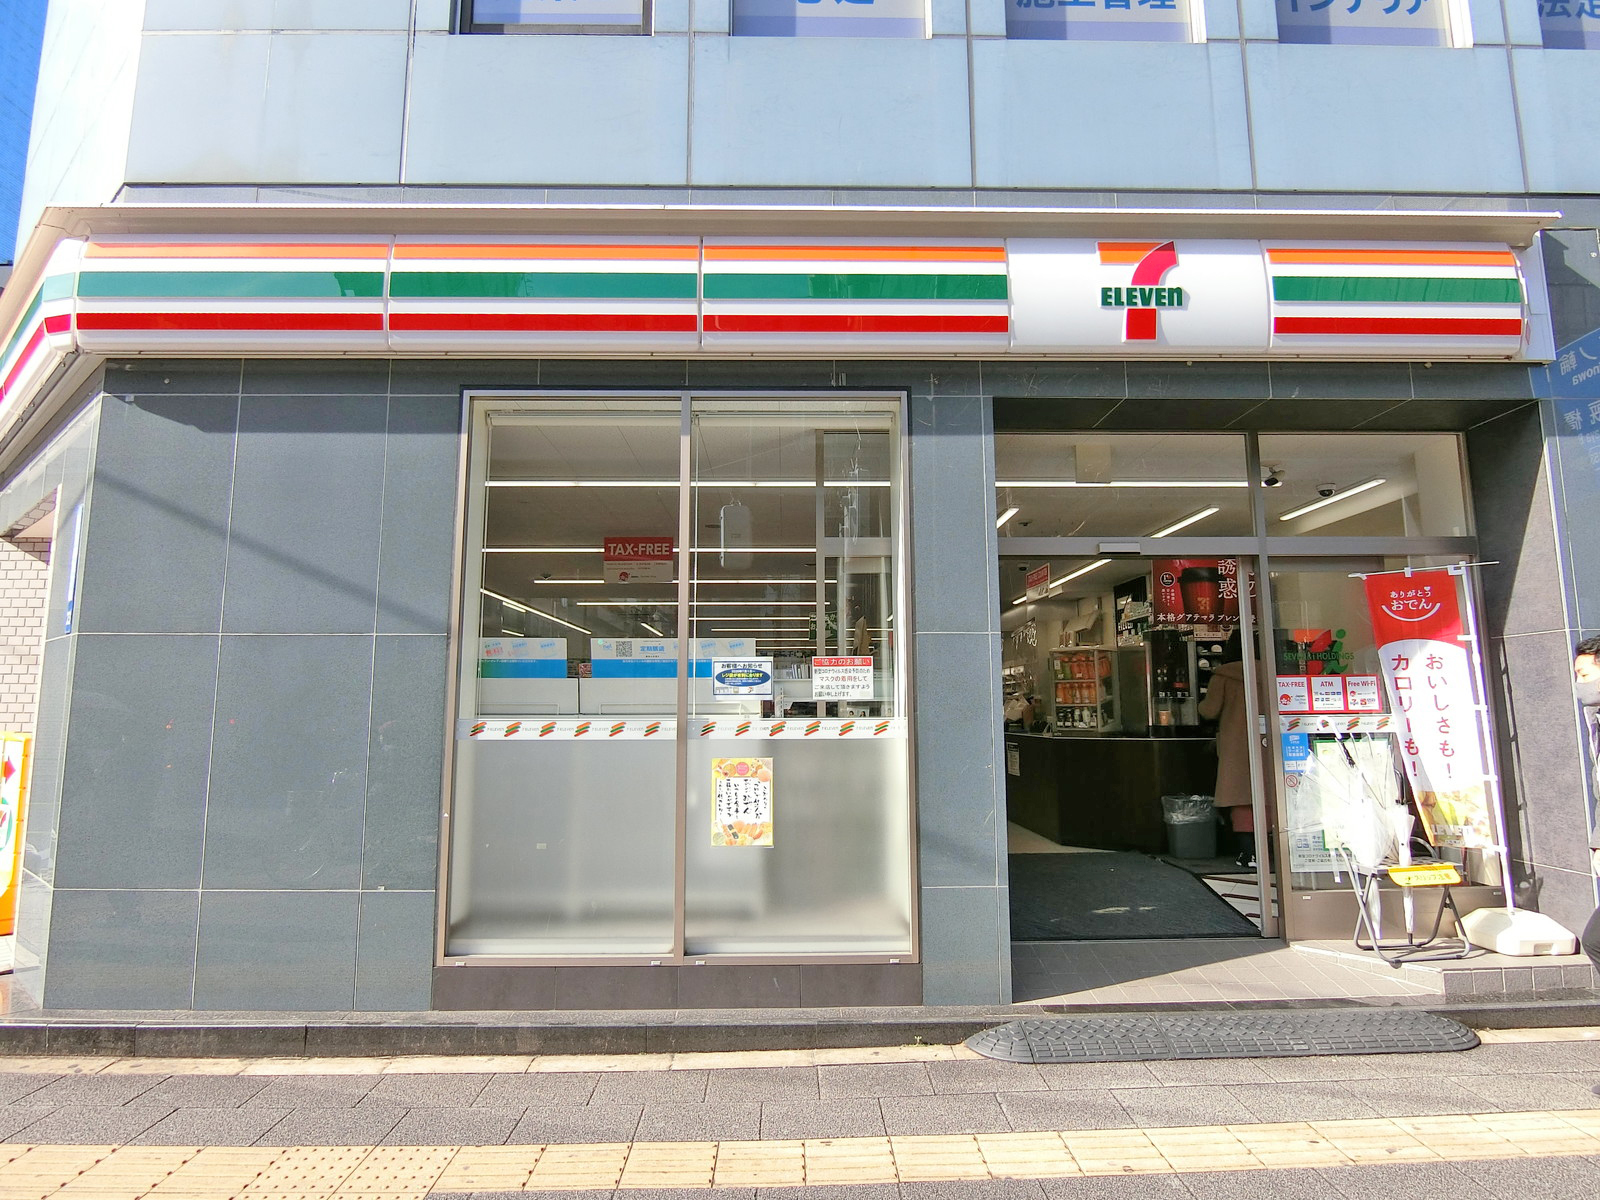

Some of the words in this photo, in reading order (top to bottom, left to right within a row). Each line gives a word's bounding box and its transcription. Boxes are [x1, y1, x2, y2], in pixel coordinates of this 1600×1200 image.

[607, 543, 670, 556] TAX-FREE
[1217, 558, 1237, 599] 誘惑
[1390, 587, 1431, 598] ありがとう
[1391, 598, 1432, 611] おでん
[814, 658, 871, 666] ご協力のお願い
[1391, 653, 1419, 777] カロリーも！
